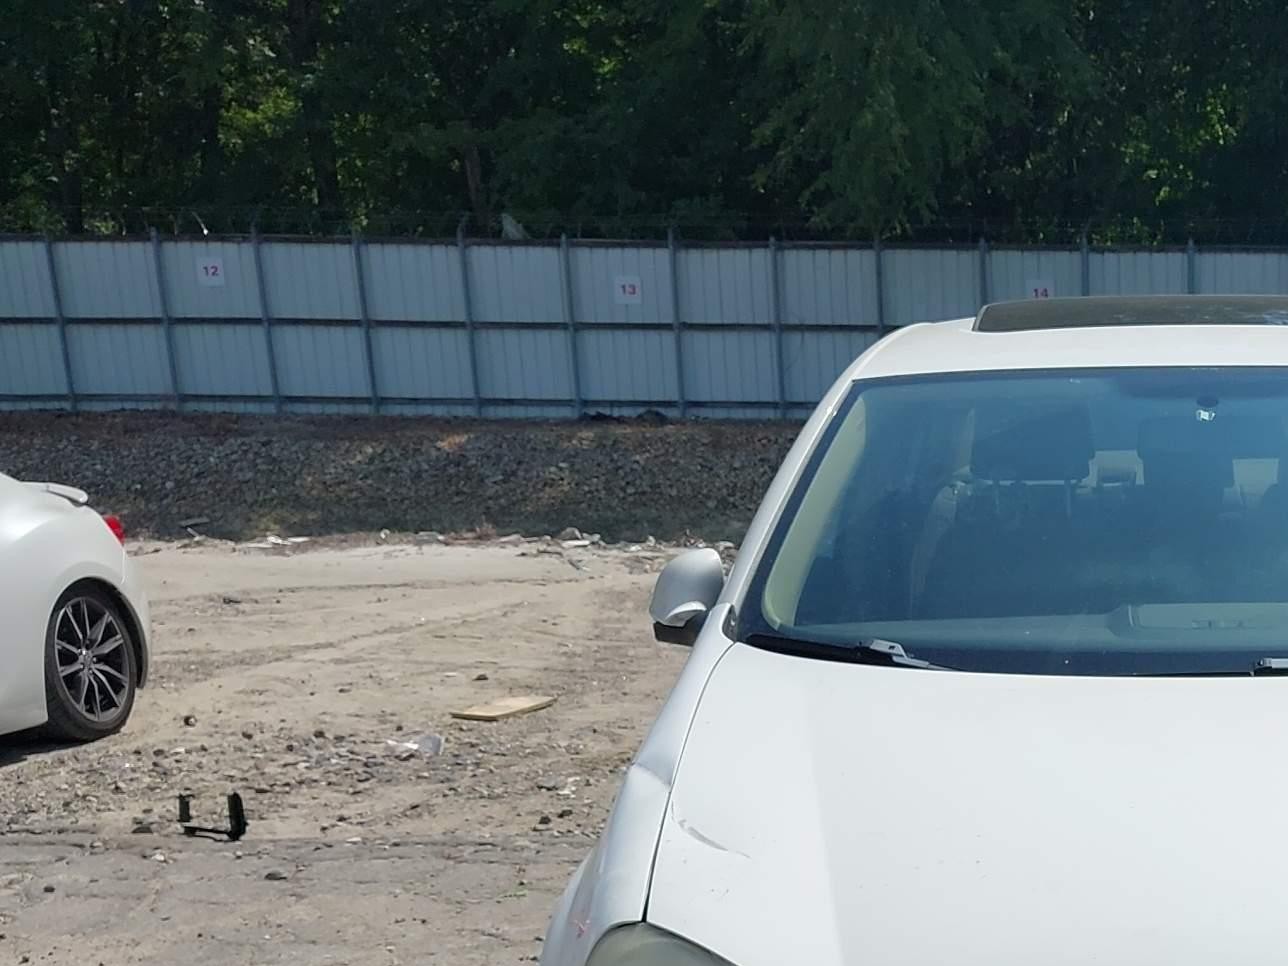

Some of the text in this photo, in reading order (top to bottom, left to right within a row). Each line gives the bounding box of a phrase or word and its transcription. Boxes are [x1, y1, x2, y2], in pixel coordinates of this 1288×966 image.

[202, 265, 219, 277] 12
[620, 284, 636, 296] 13
[1033, 288, 1048, 298] 14
